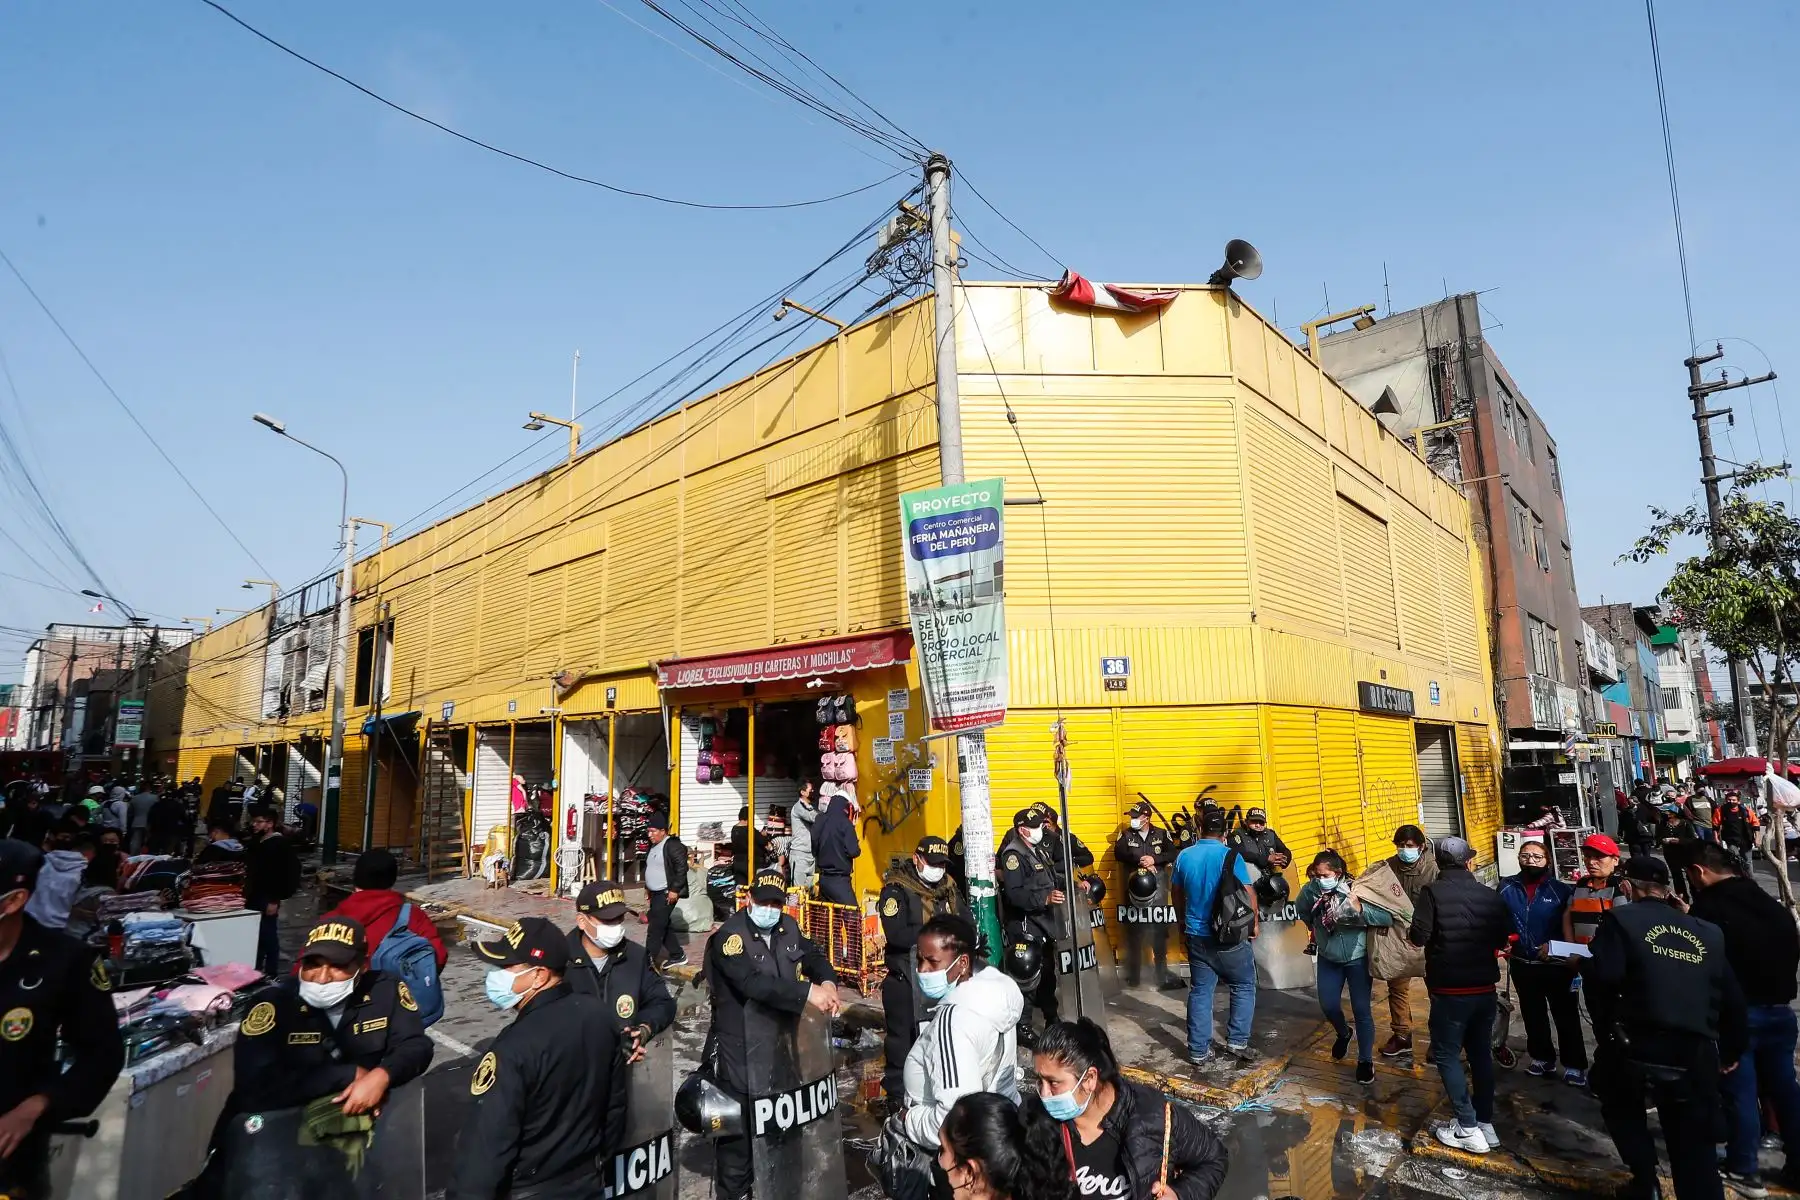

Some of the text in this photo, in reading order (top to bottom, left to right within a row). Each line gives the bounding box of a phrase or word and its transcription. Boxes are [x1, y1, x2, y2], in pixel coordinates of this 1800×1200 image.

[912, 491, 991, 513] PROYECTO
[923, 515, 982, 531] Centro Comercial
[912, 522, 996, 545] FERIA MAÑANERA
[930, 534, 976, 552] DEL PERÚ
[918, 619, 932, 631] SE
[921, 630, 934, 641] DE
[962, 631, 1000, 647] LOCAL
[754, 661, 764, 675] EN
[765, 656, 801, 673] CARTERAS
[803, 655, 809, 668] Y
[1107, 660, 1124, 674] 36
[306, 922, 354, 947] POLICIA
[1645, 924, 1708, 957] POLICIA NACIONAL
